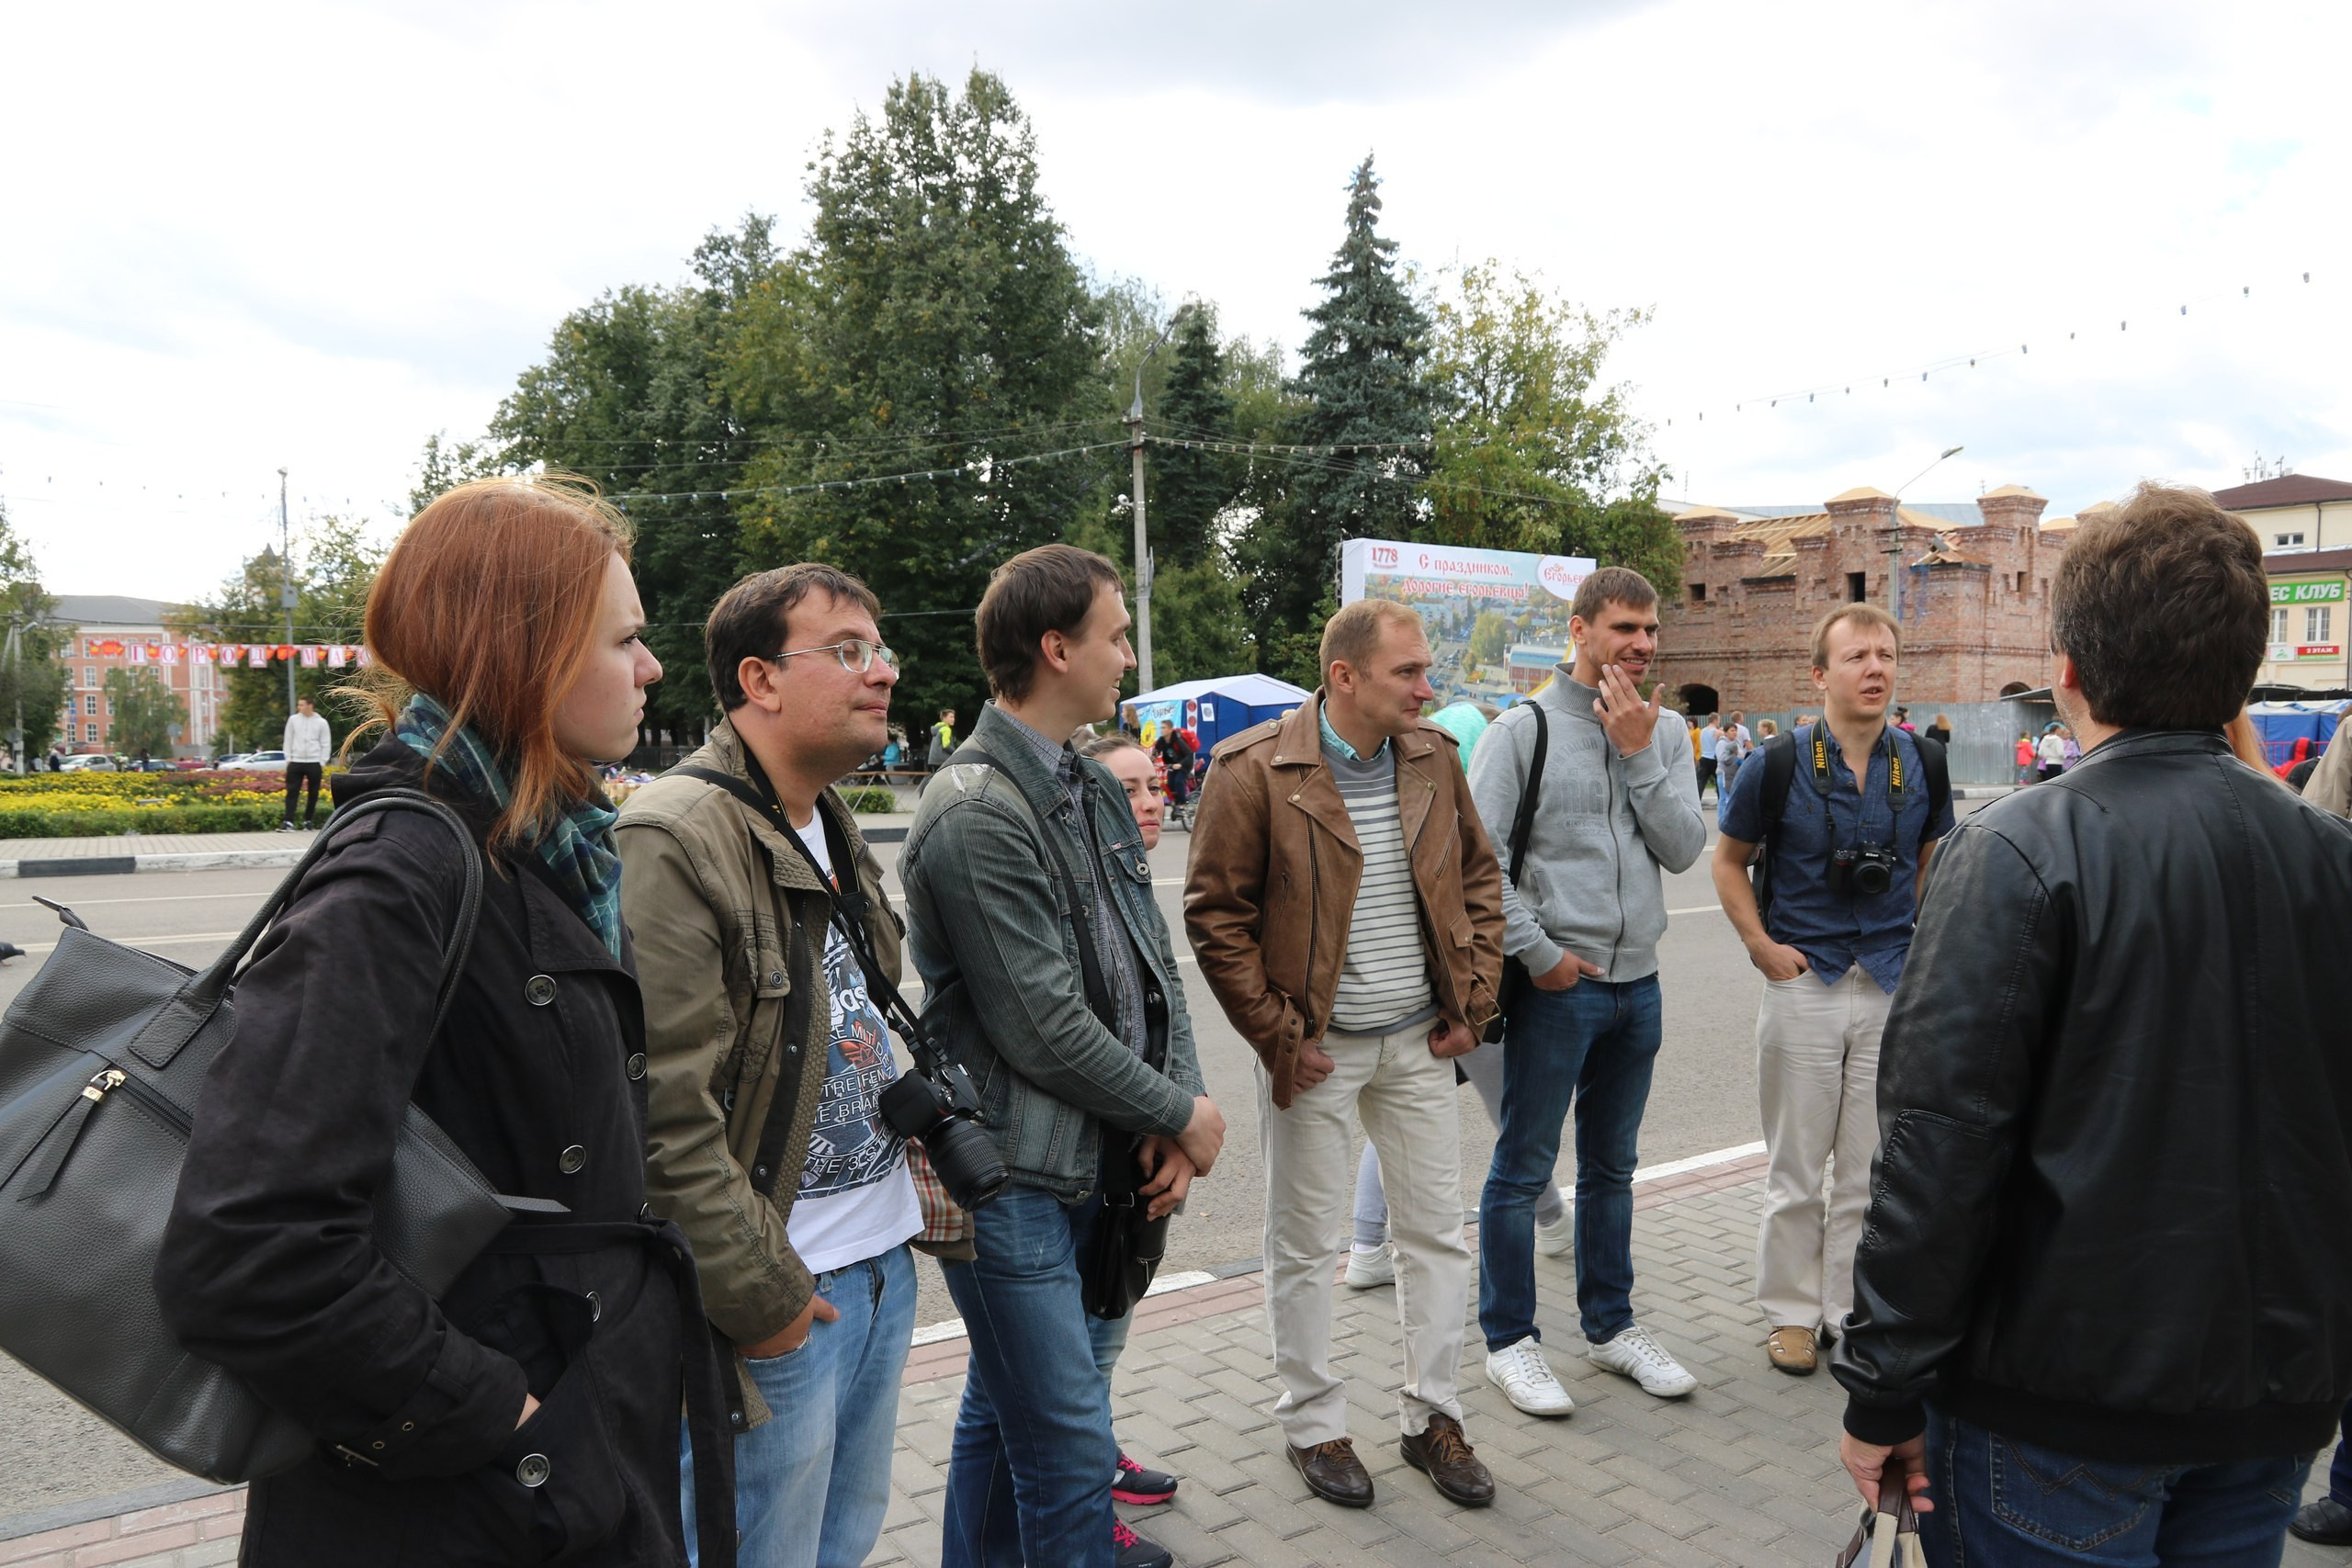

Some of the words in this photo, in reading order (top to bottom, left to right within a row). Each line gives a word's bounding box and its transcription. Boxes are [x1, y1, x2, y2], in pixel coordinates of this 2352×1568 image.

[1372, 547, 1397, 562] 1778
[1419, 553, 1429, 570] С
[1434, 559, 1513, 577] праздником,
[1544, 567, 1589, 585] Егорьев
[2270, 586, 2290, 601] ЕС
[2295, 582, 2342, 601] КЛУБ
[131, 645, 265, 665] ГОРОД
[1815, 740, 1826, 769] Nikon
[1893, 757, 1901, 787] Nikon
[851, 1024, 874, 1044] MIT
[820, 1066, 886, 1098] TREIFEN
[838, 1095, 880, 1118] BRAN
[847, 1156, 859, 1171] 3
[865, 1126, 890, 1163] STR
